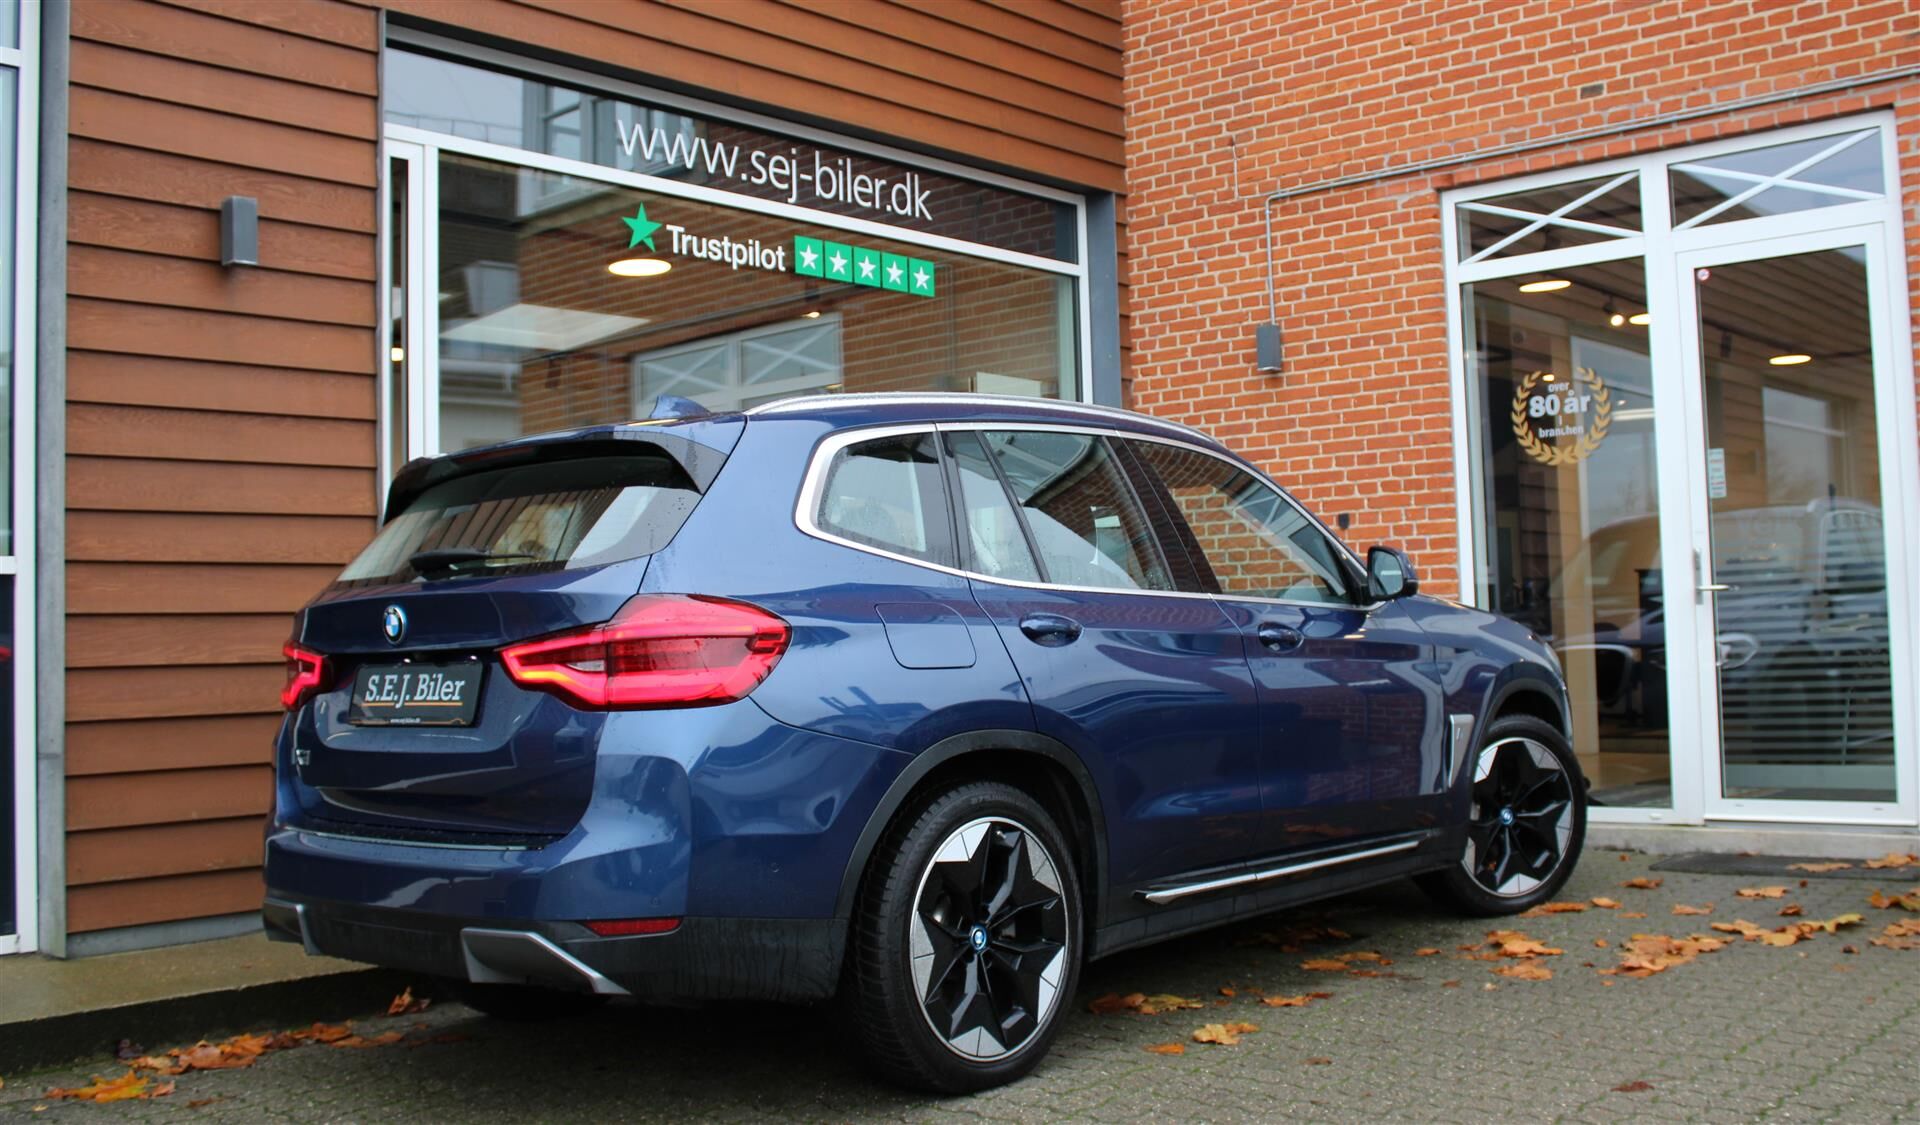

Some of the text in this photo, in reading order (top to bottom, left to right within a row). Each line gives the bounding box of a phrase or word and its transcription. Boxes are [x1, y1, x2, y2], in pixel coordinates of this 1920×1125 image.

[618, 119, 934, 221] www.sej-biler.dk
[666, 224, 786, 272] Trustpilot
[1529, 389, 1591, 418] 80 år
[1548, 383, 1569, 392] over
[365, 673, 465, 708] S.E.J. Biler
